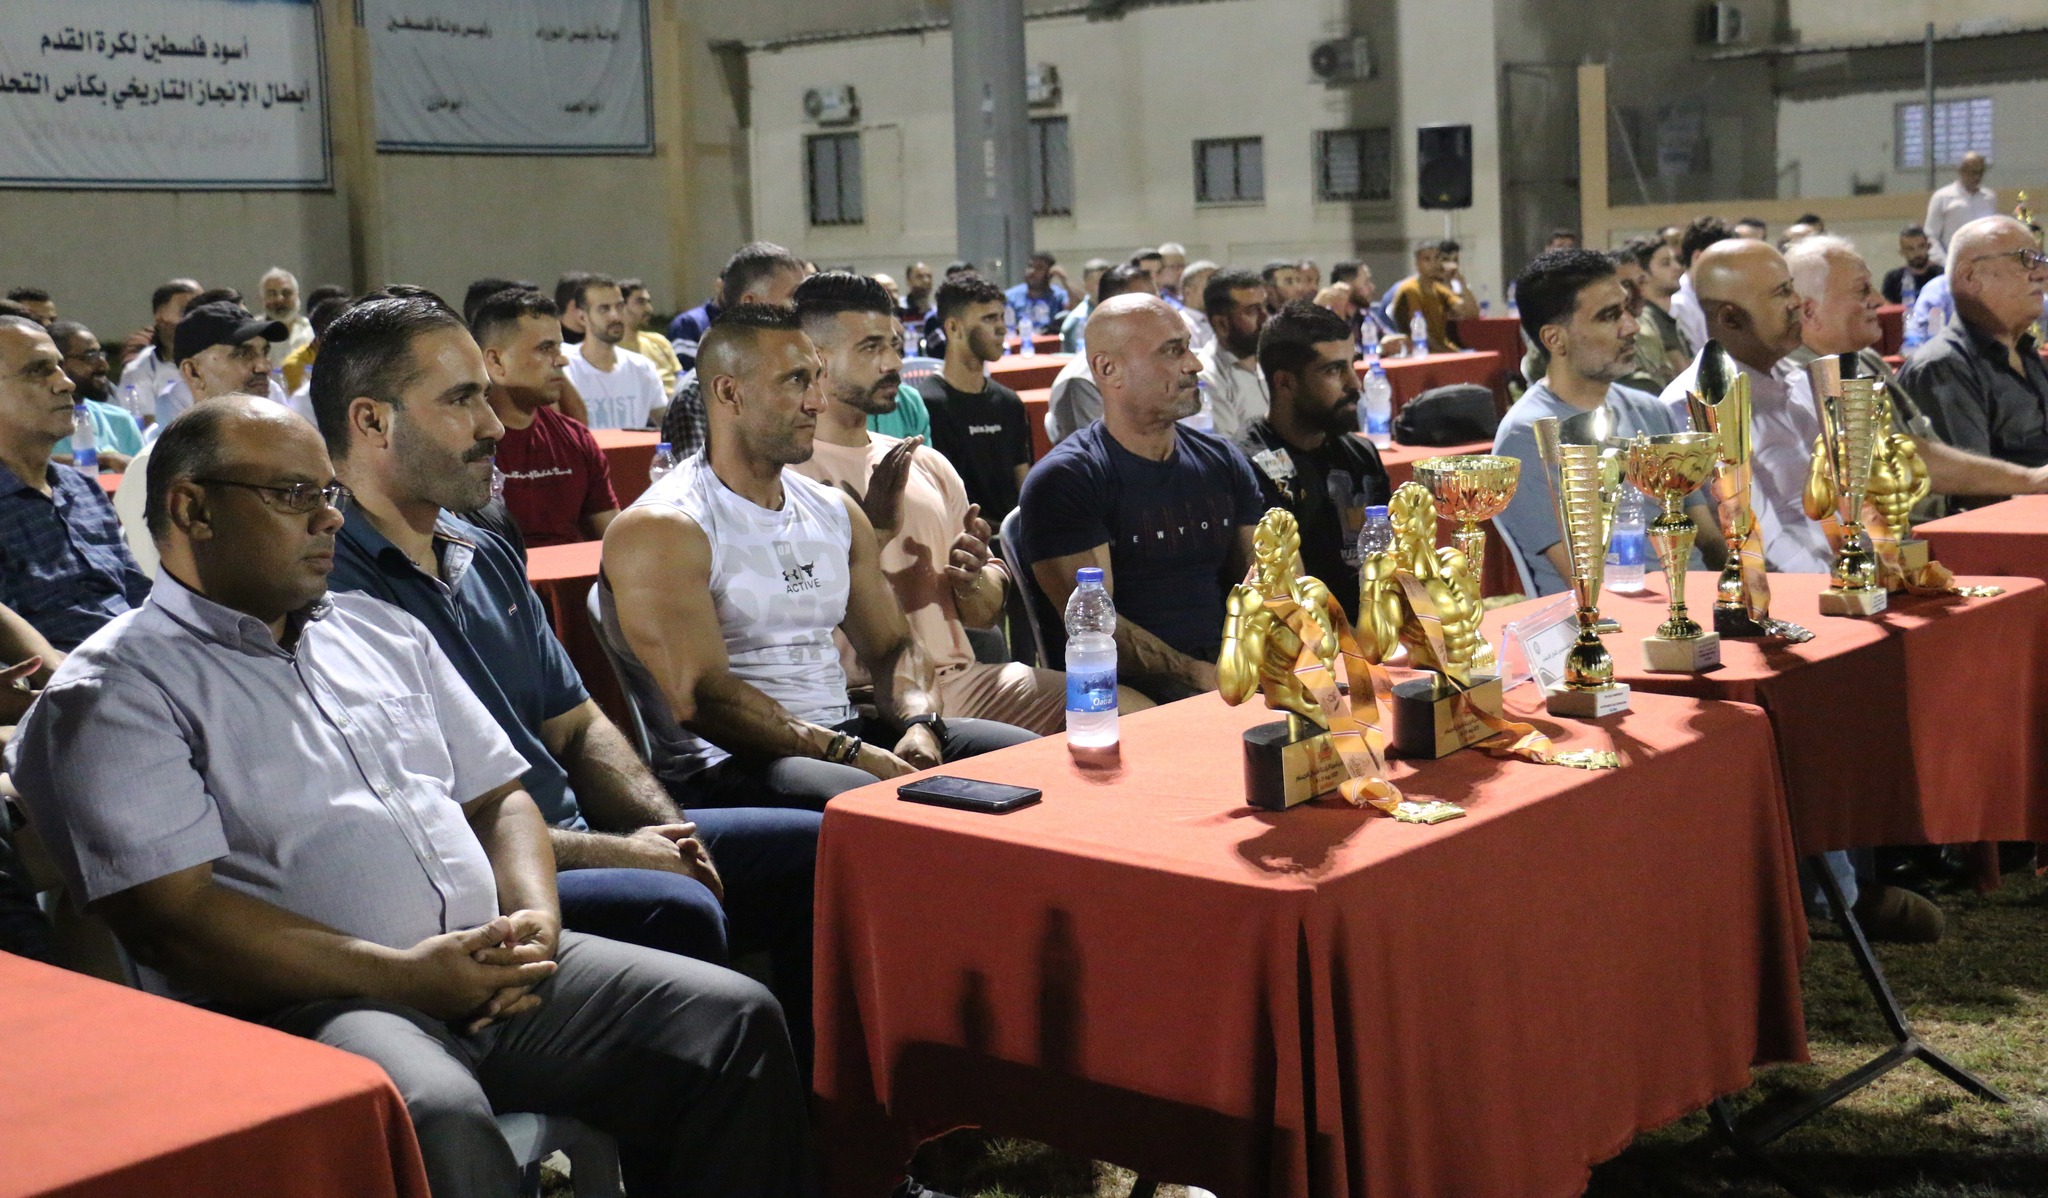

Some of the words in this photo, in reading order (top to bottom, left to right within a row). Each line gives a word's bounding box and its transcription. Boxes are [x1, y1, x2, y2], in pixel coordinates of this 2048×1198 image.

[40, 27, 92, 55] القدم
[96, 31, 137, 60] لكرة
[143, 34, 207, 63] فلسطين
[0, 71, 50, 96] التحد
[112, 77, 193, 110] التاريخي
[786, 577, 821, 594] ACTIVE
